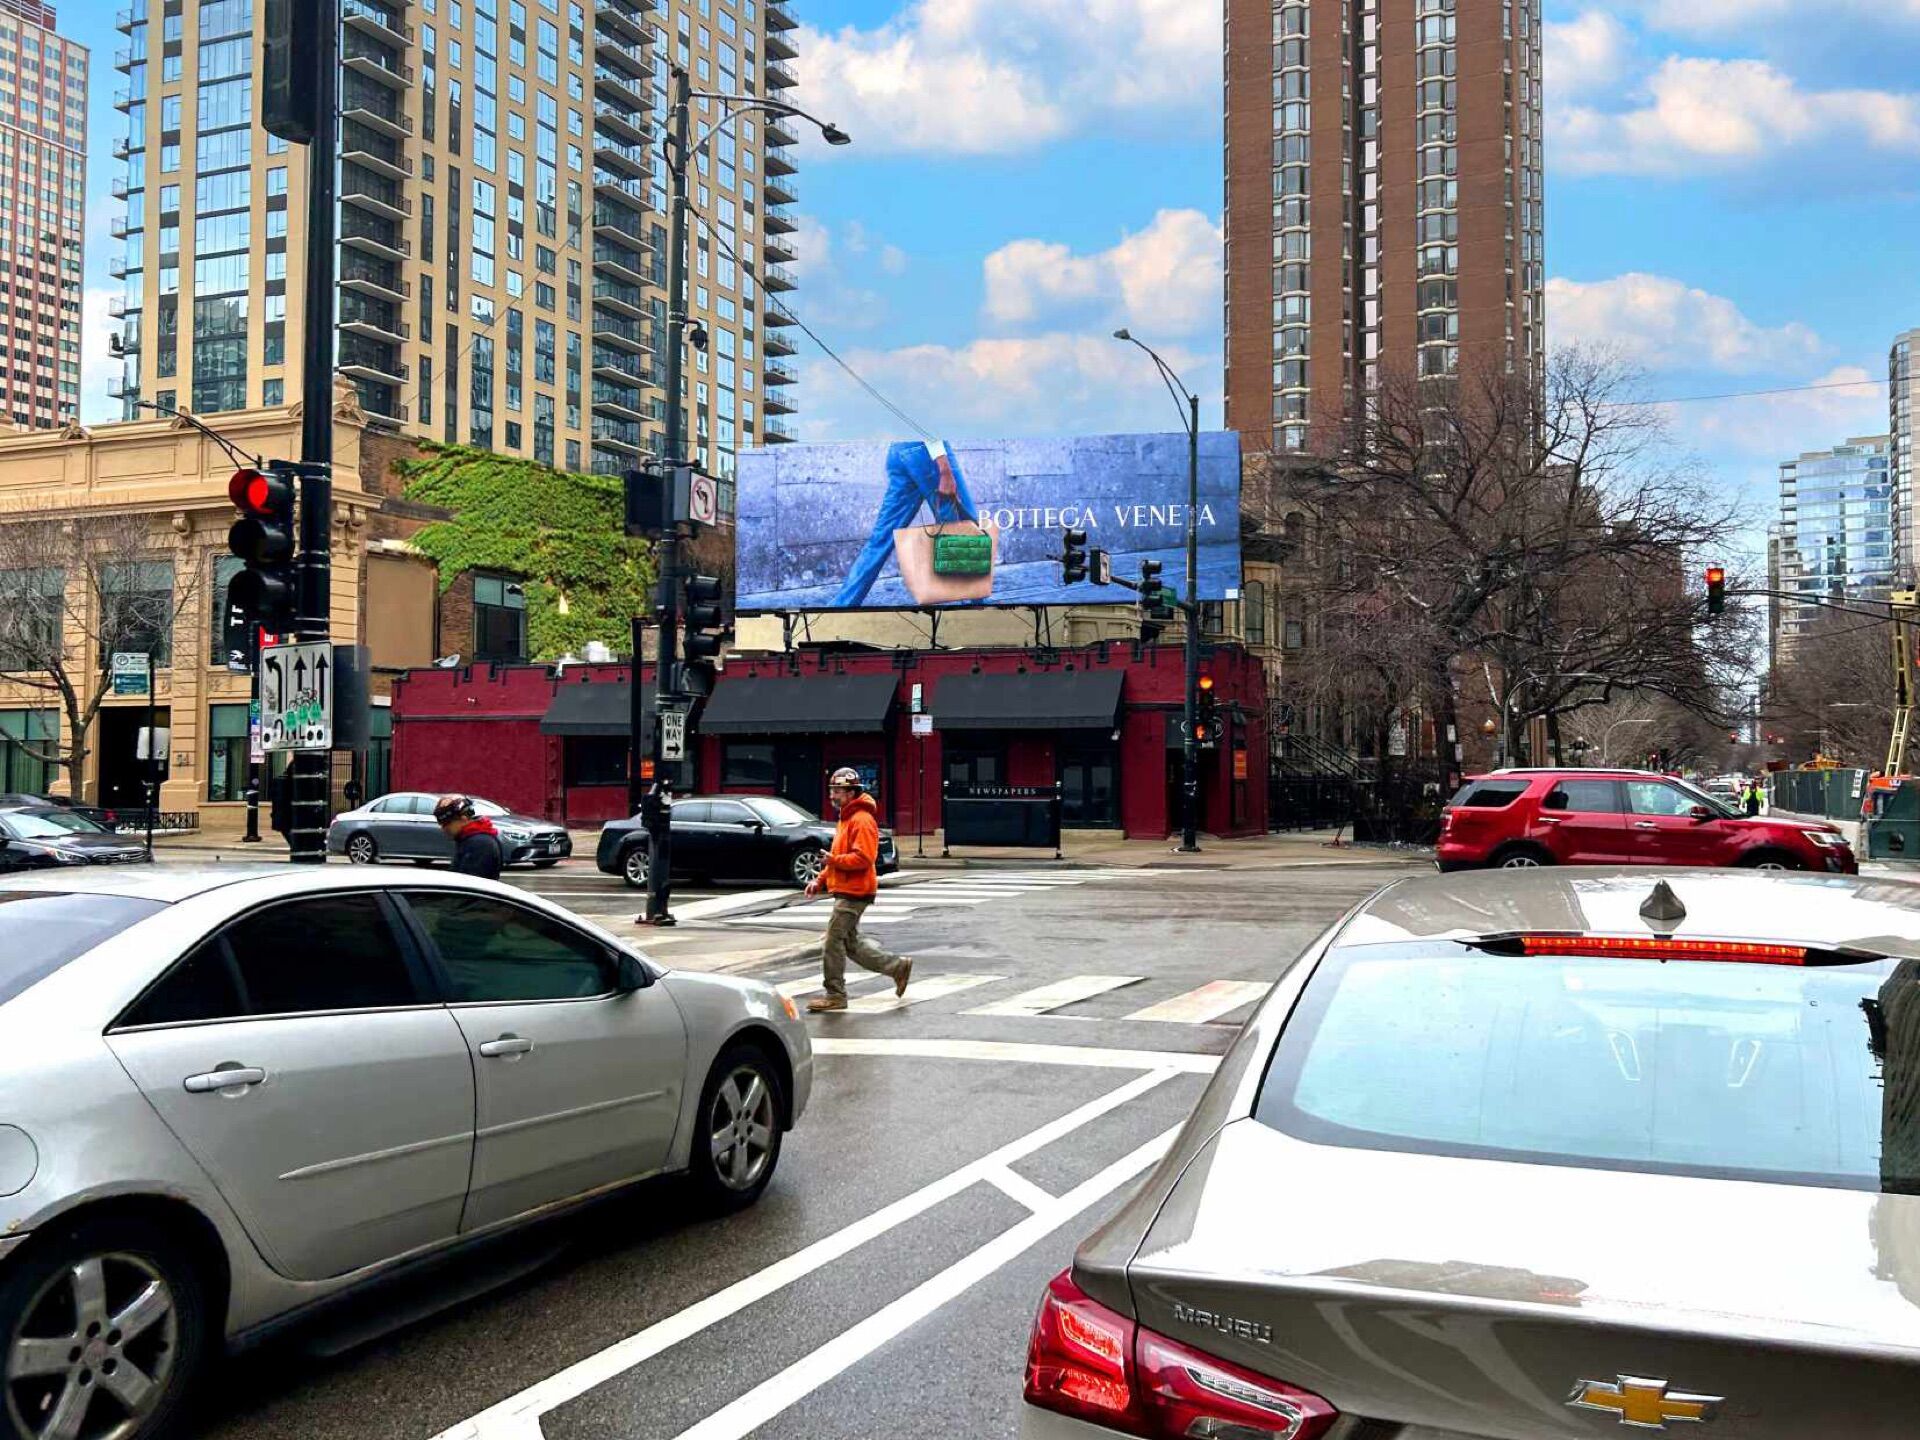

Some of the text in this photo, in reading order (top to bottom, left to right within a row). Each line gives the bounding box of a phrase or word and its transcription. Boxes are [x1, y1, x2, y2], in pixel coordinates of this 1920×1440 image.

[977, 506, 1098, 530] BOTTEGA
[666, 714, 682, 728] ONE
[666, 728, 682, 740] WAY
[1174, 1303, 1274, 1344] MALIBU
